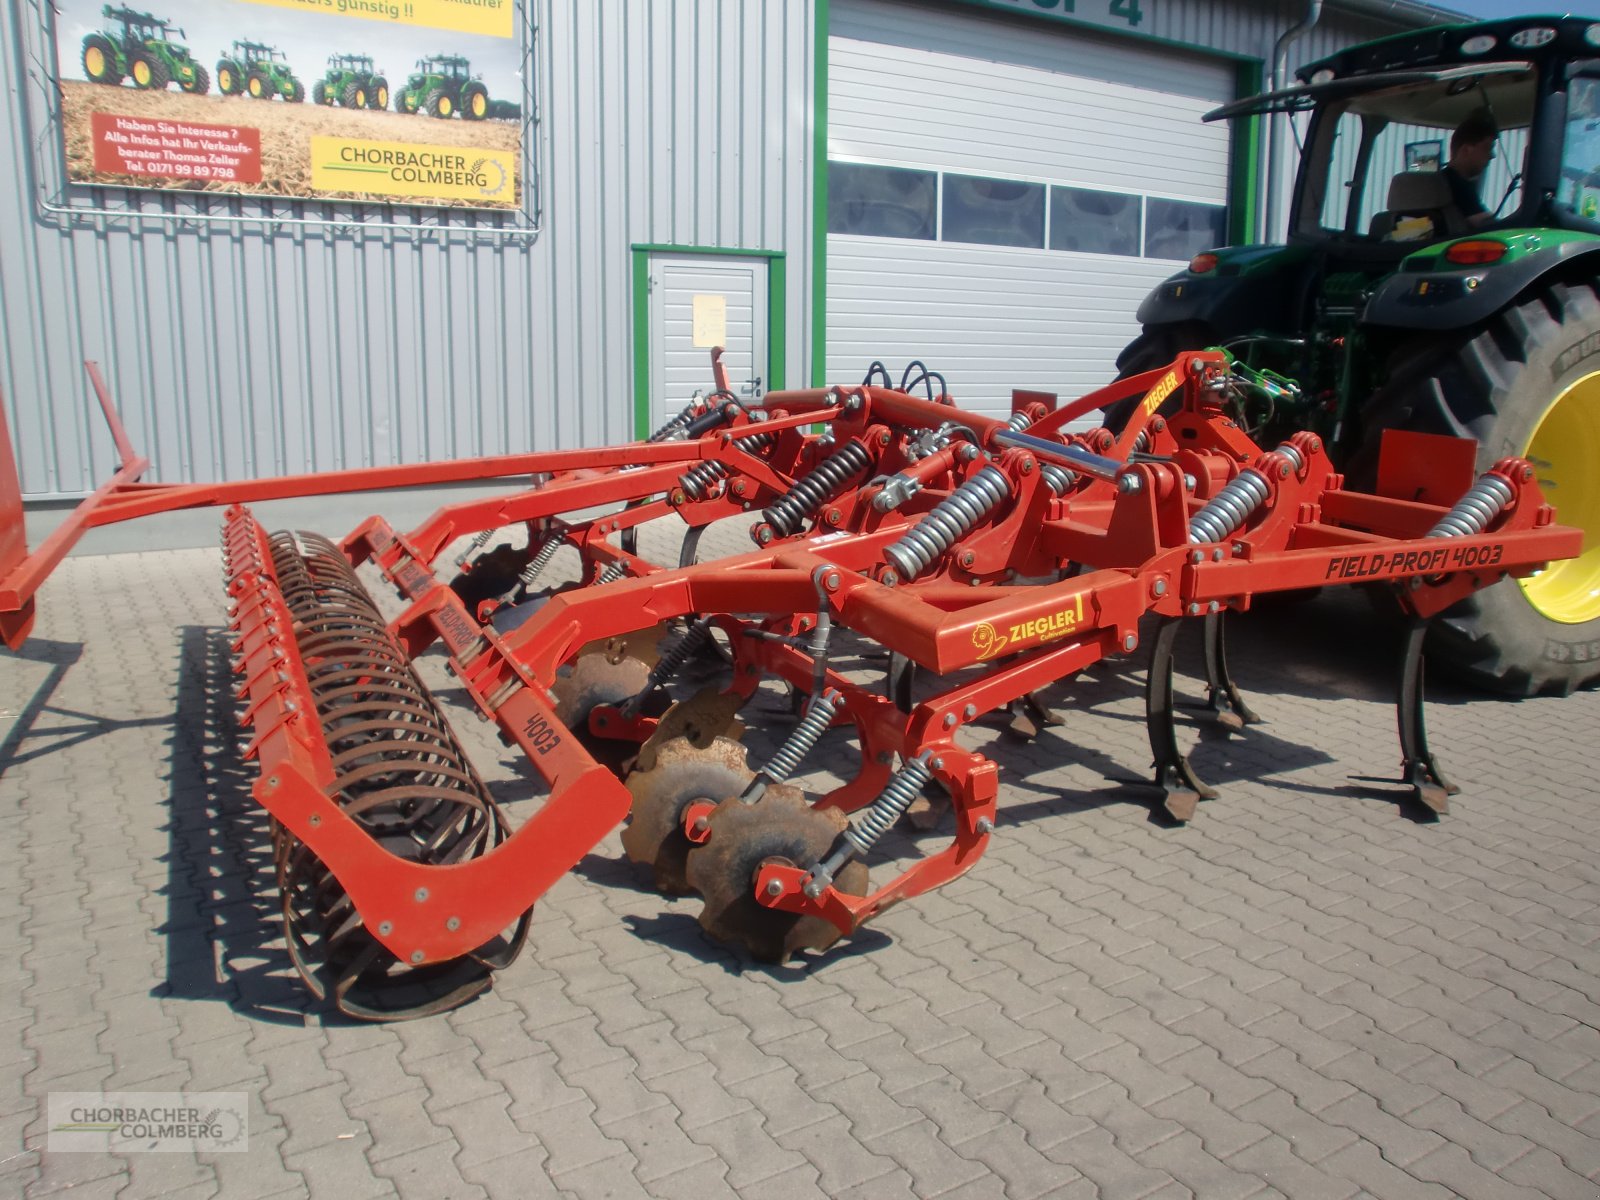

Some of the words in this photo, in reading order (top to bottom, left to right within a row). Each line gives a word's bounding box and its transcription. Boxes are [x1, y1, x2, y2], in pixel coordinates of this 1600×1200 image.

[1109, 0, 1143, 27] 4
[116, 118, 155, 132] Haben
[158, 122, 176, 134] Sie
[177, 124, 229, 139] Interesse
[231, 129, 238, 139] ?
[104, 131, 128, 144] Alle
[130, 133, 160, 146] Infos
[162, 136, 181, 148] hat
[183, 138, 199, 149] Ihr
[200, 140, 253, 154] Verkaufs-
[117, 146, 161, 160] berater
[162, 149, 207, 163] Thomas
[208, 153, 240, 165] Zeller
[340, 147, 466, 170] CHORBACHER
[124, 160, 145, 172] Tel.
[147, 162, 172, 173] 0171
[175, 164, 191, 176] 99
[193, 165, 209, 177] 89
[211, 166, 235, 178] 798
[390, 167, 488, 187] COLMBERG
[1143, 371, 1178, 417] ZIEGLER
[1325, 549, 1450, 579] FIELD-PROFI
[1453, 545, 1504, 567] 4003
[1009, 609, 1076, 643] ZIEGLER
[523, 712, 562, 756] 4003
